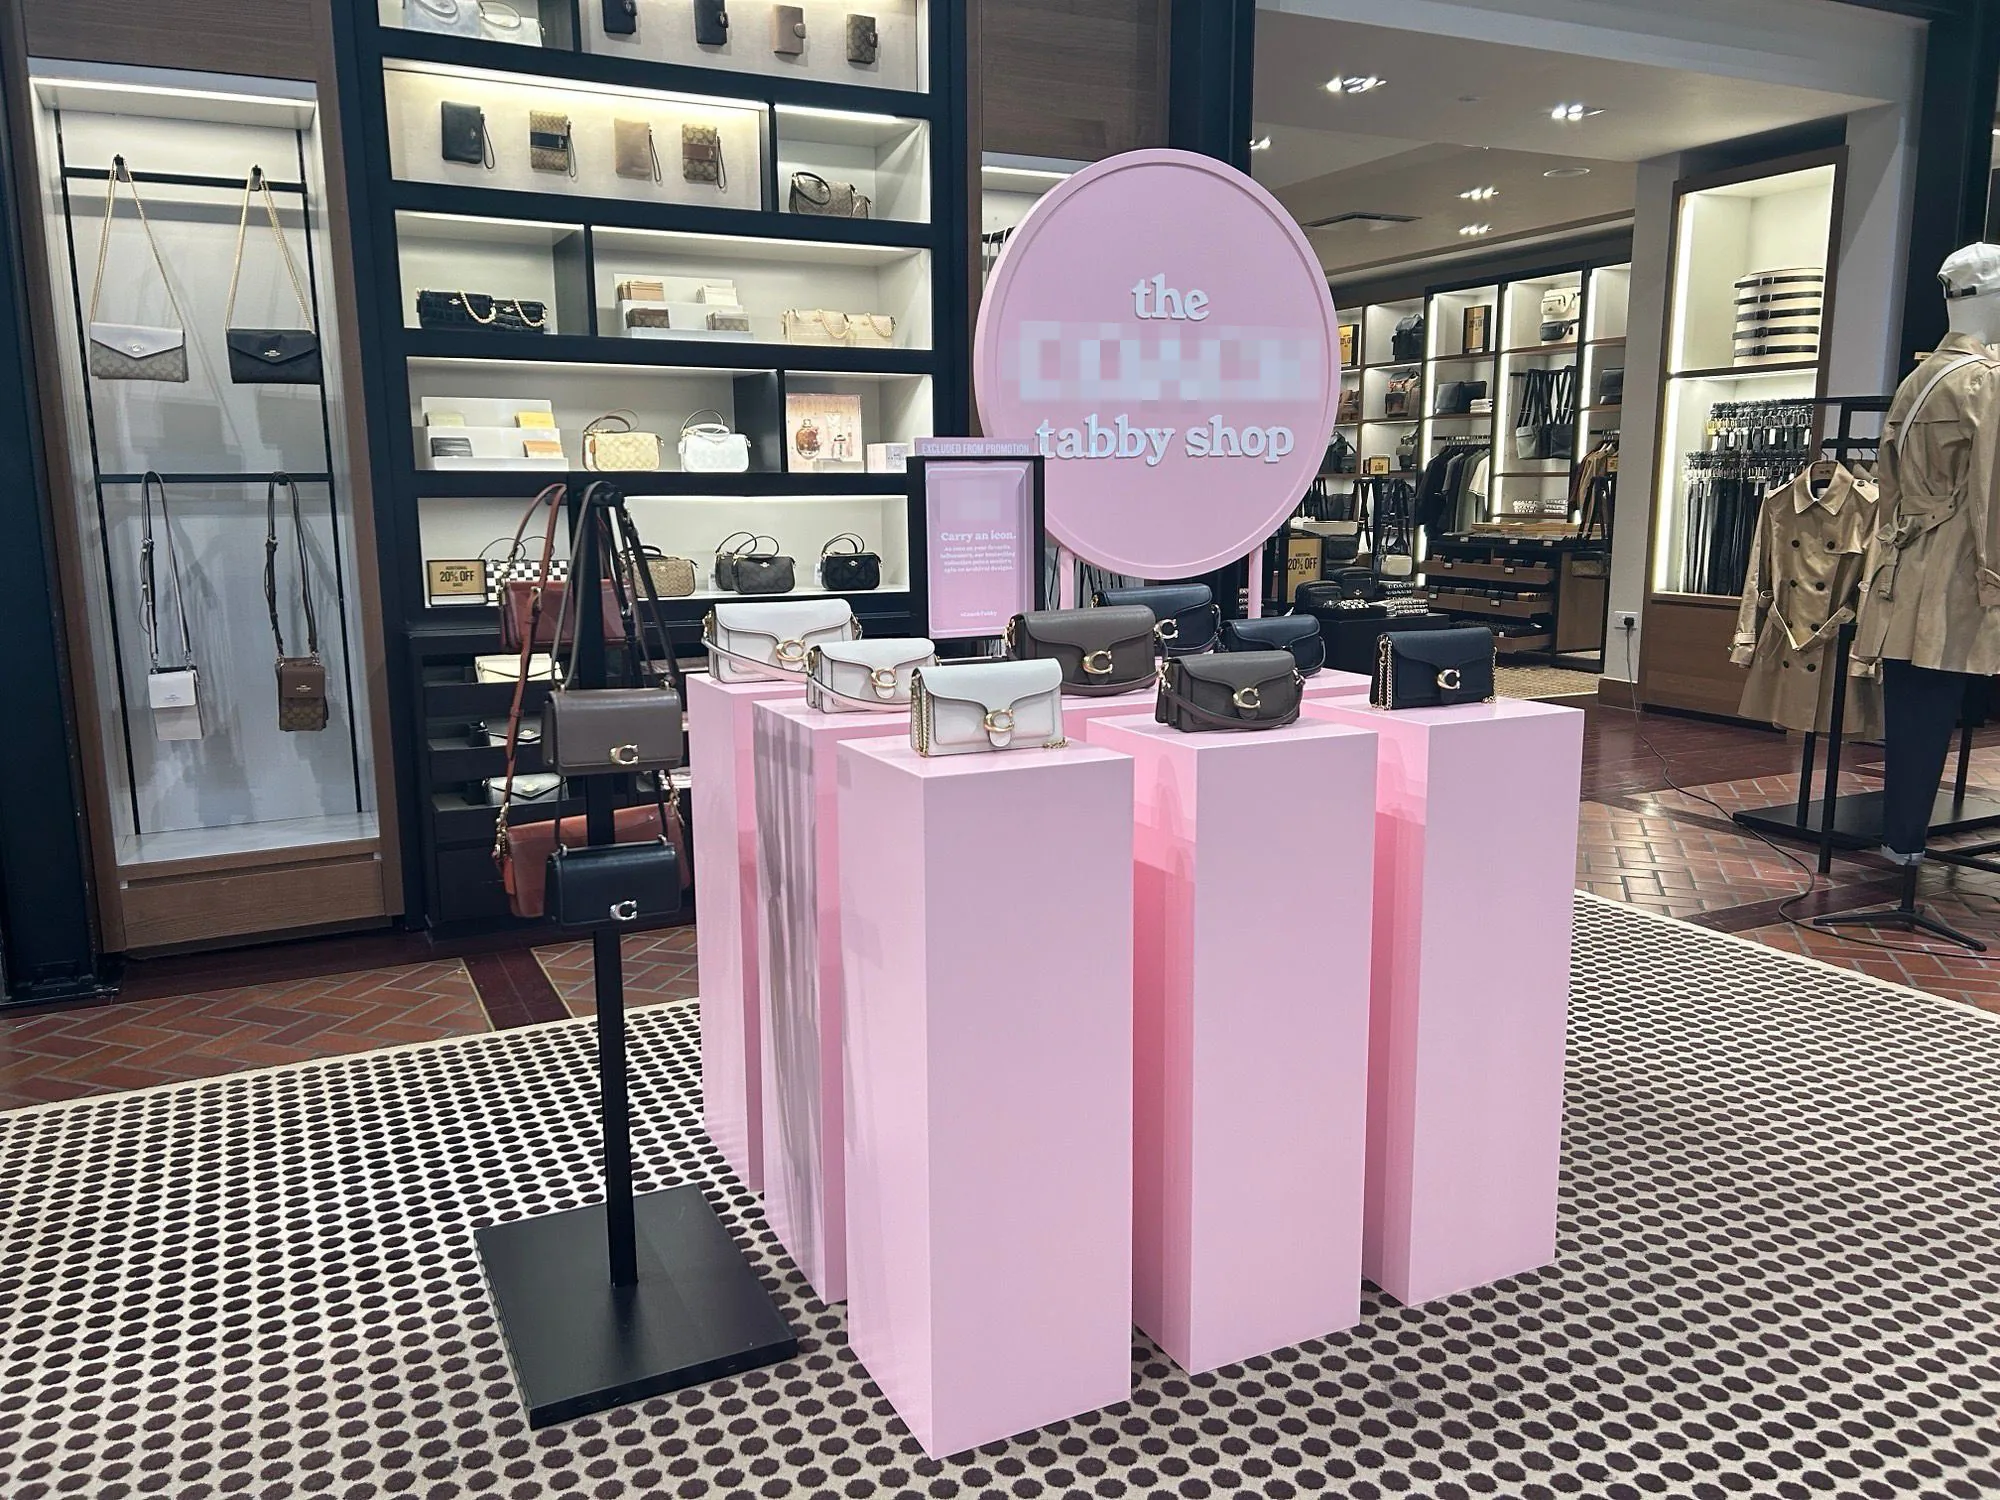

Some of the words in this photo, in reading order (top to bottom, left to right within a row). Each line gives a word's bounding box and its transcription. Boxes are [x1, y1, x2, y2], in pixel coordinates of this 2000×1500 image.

[1131, 272, 1210, 322] the
[1036, 413, 1175, 466] tabby
[1185, 414, 1295, 463] shop
[922, 443, 961, 454] EXCLUDED
[963, 443, 985, 454] FROM
[985, 443, 1029, 454] PROMOTION
[940, 532, 973, 543] Carry
[975, 532, 989, 540] an
[990, 530, 1016, 540] icon.
[1287, 558, 1303, 570] 20%
[1304, 557, 1318, 570] OFF
[440, 571, 458, 582] 20%
[459, 570, 474, 582] OFF
